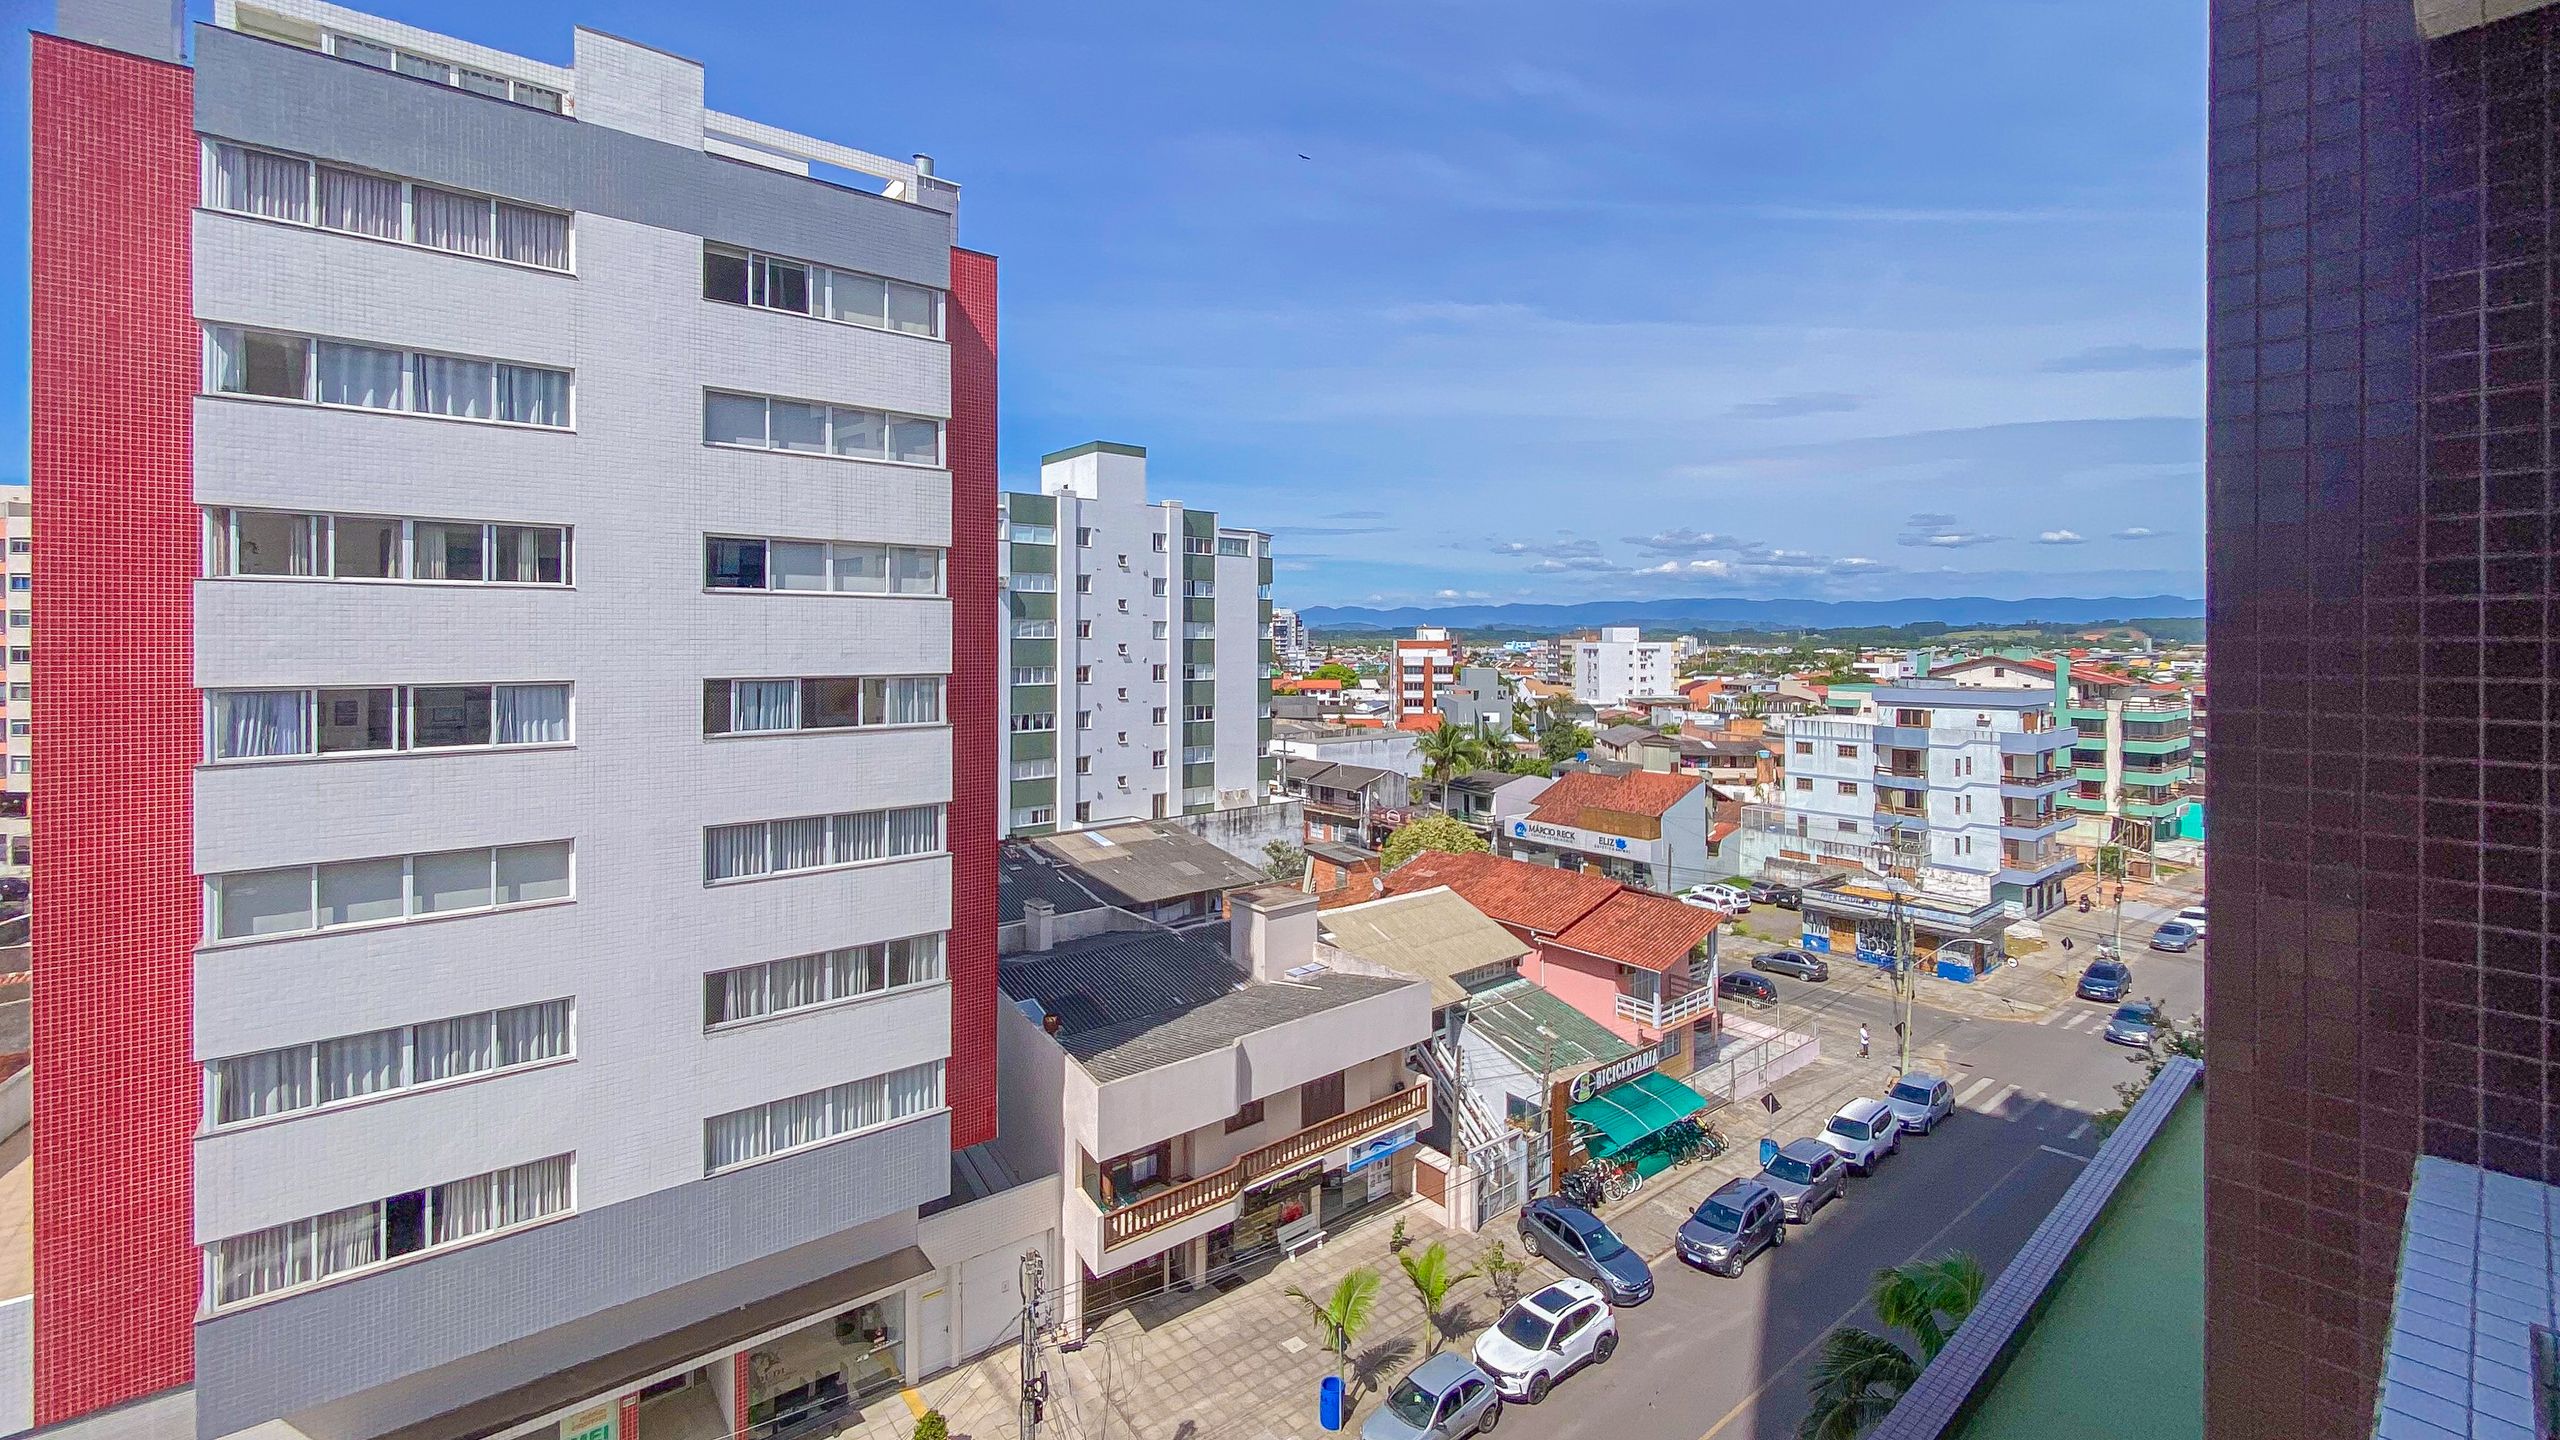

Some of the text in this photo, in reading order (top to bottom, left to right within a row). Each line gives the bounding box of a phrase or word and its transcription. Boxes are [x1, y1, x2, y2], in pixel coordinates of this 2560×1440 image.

[1556, 829, 1576, 840] RECK
[1598, 836, 1615, 847] ELIZ
[1596, 1048, 1659, 1089] BICICLETARIA
